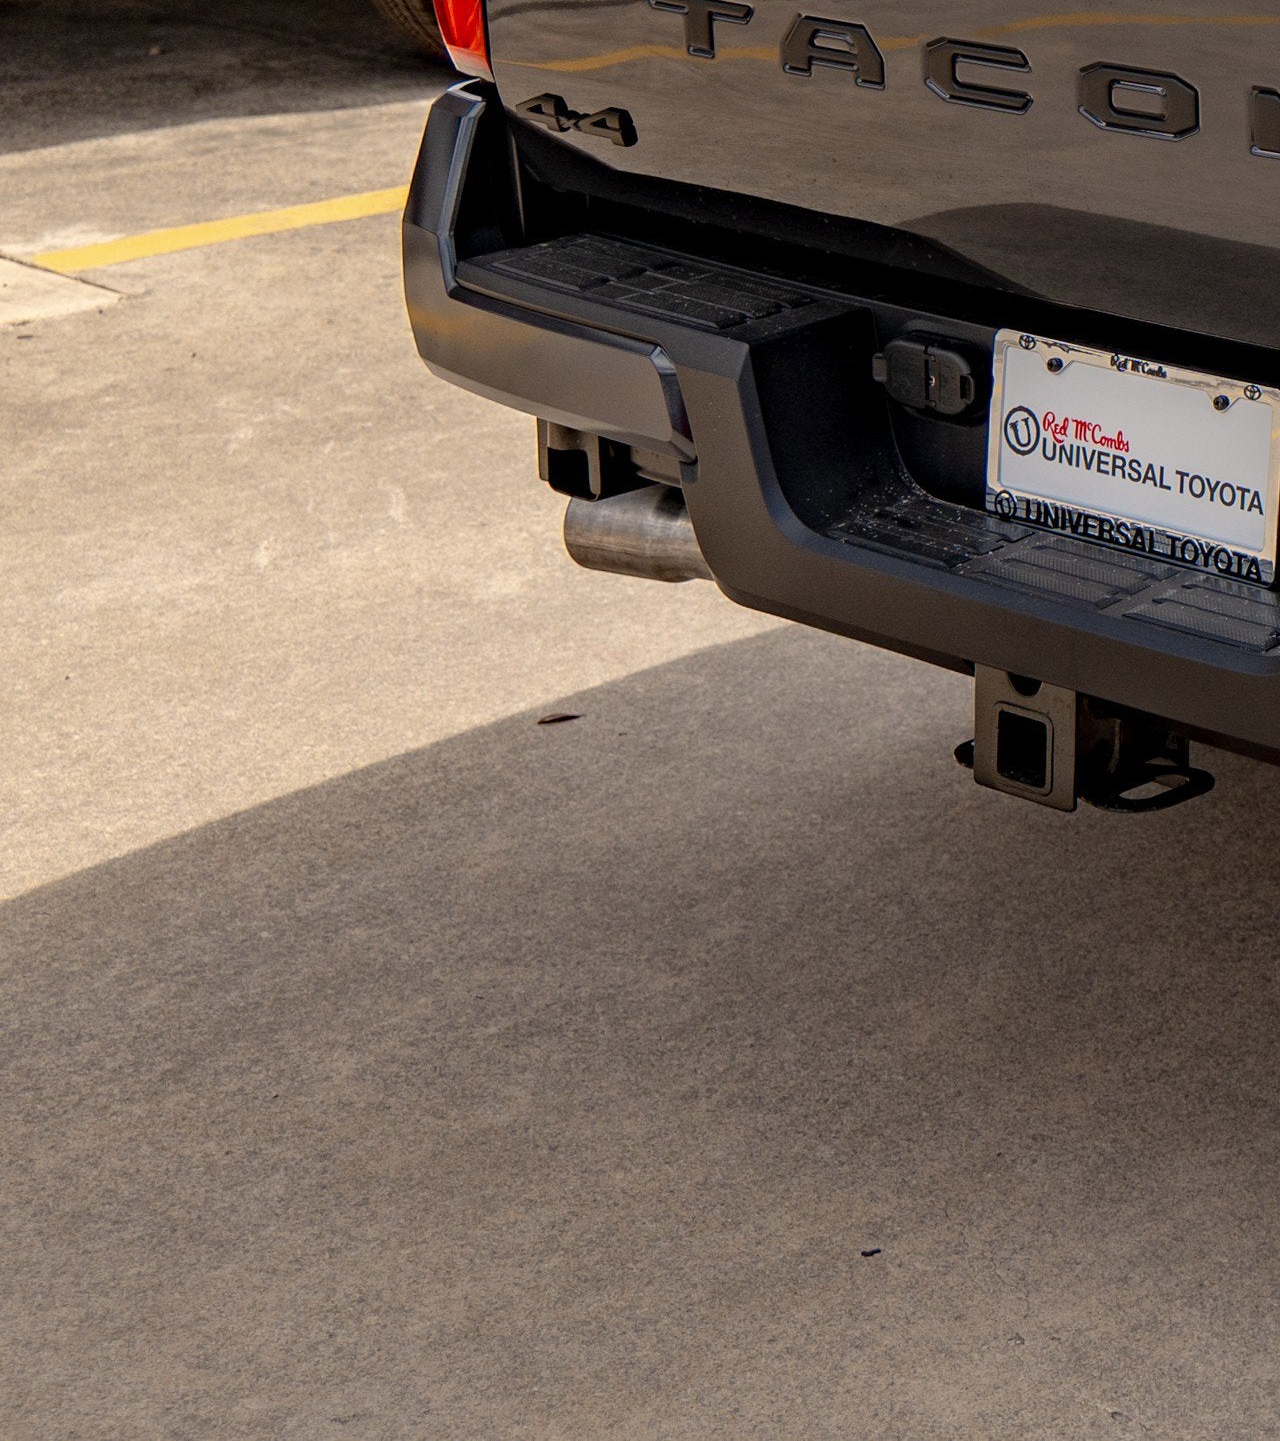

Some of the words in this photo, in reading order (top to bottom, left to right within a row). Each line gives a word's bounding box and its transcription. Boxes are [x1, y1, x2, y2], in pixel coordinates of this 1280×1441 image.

[1042, 411, 1069, 444] Red
[1071, 417, 1130, 453] McCombs
[1041, 437, 1172, 492] UNIVERSAL
[1174, 469, 1265, 516] TOYOTA
[1025, 498, 1164, 553] UNIVERSAL
[1165, 534, 1263, 583] TOYOTA
